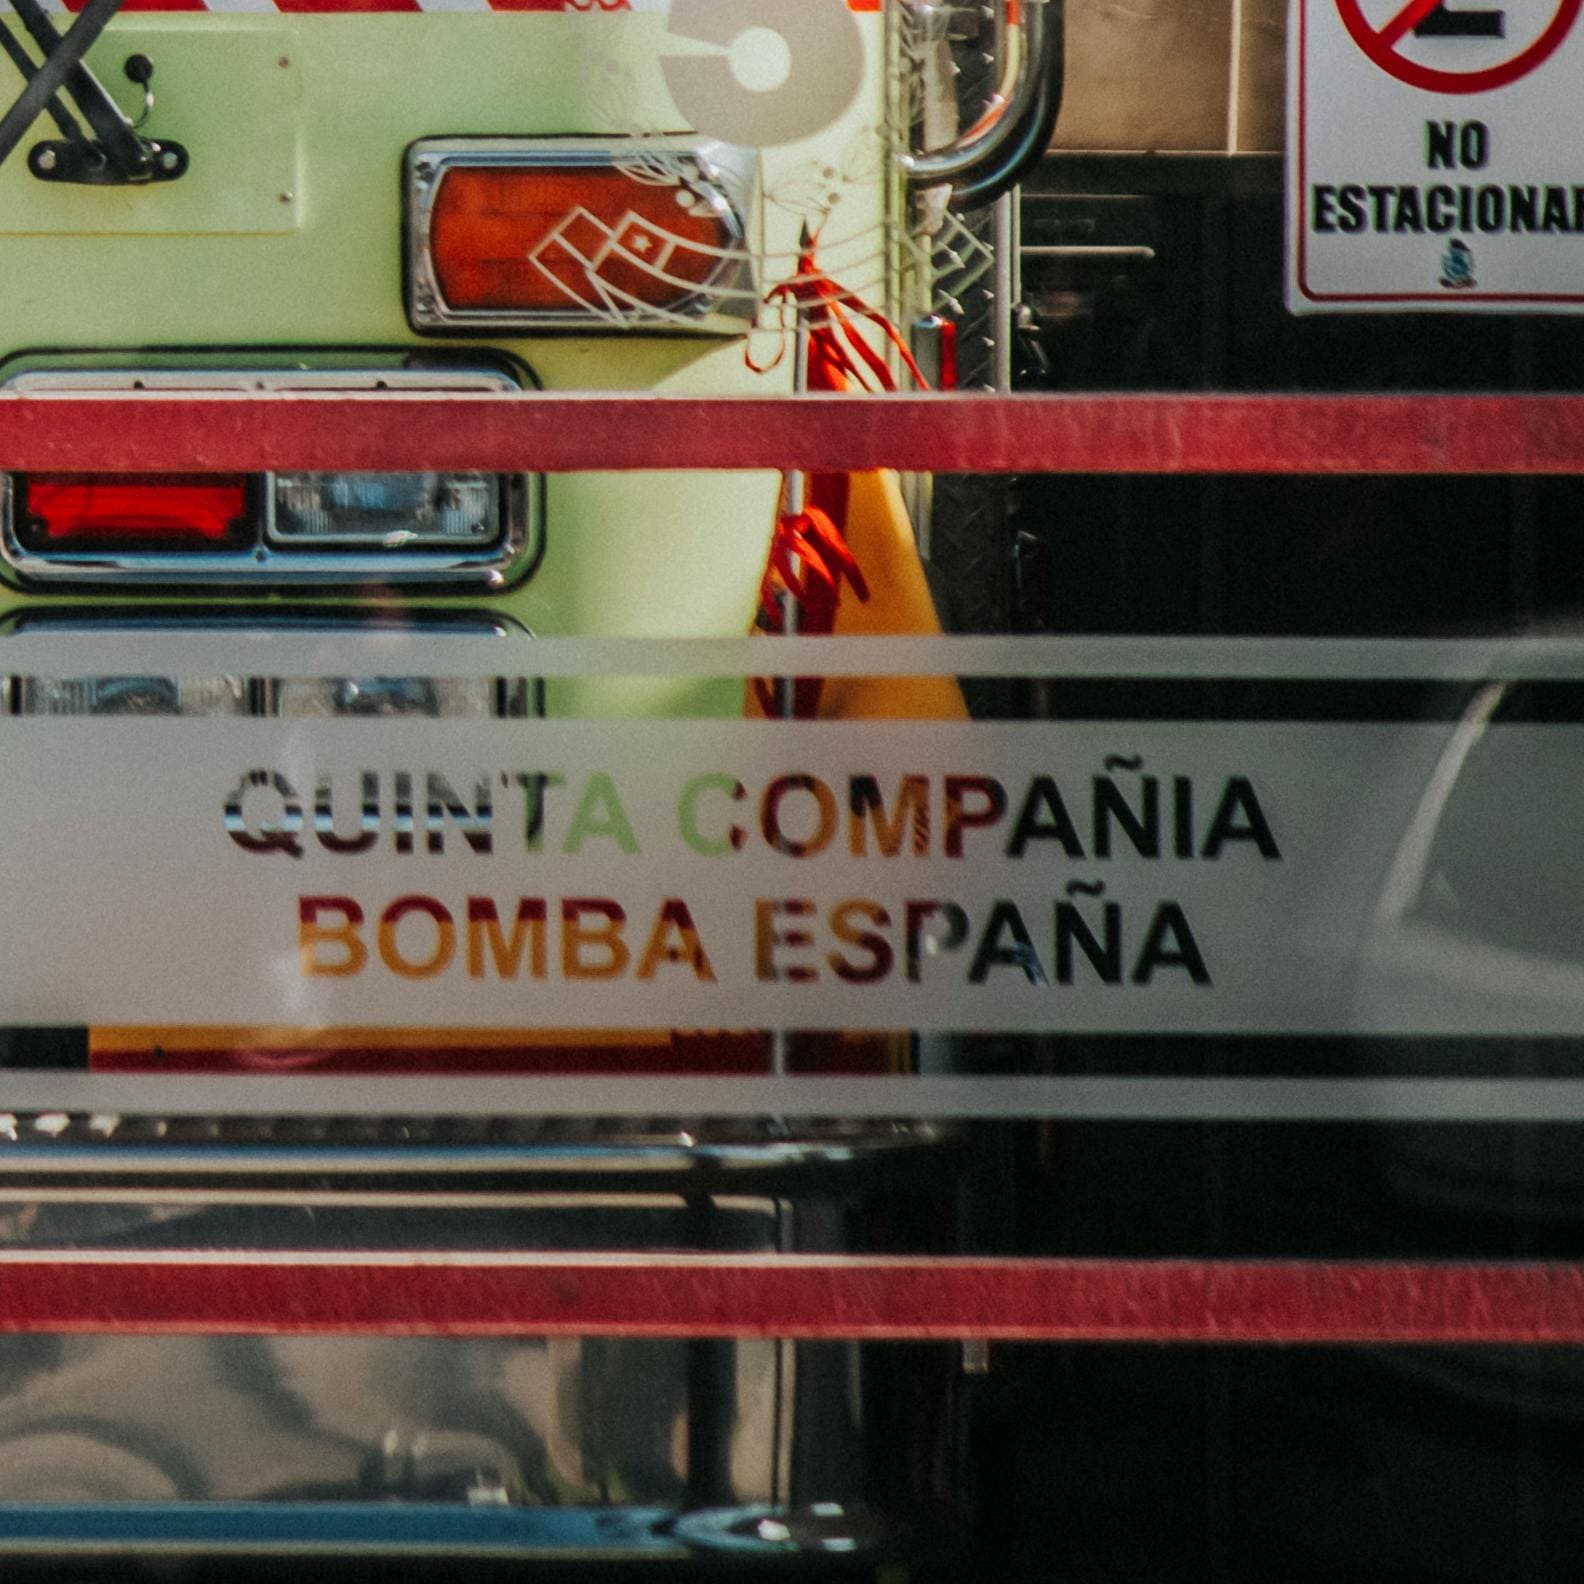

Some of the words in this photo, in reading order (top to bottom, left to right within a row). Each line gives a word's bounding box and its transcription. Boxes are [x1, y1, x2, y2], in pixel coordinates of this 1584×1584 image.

[1425, 120, 1488, 170] NO
[223, 766, 643, 860] QUINTA
[677, 754, 1282, 861] COMPAÑIA
[296, 895, 717, 983] BOMBA
[755, 880, 1215, 988] ESPAÑA
